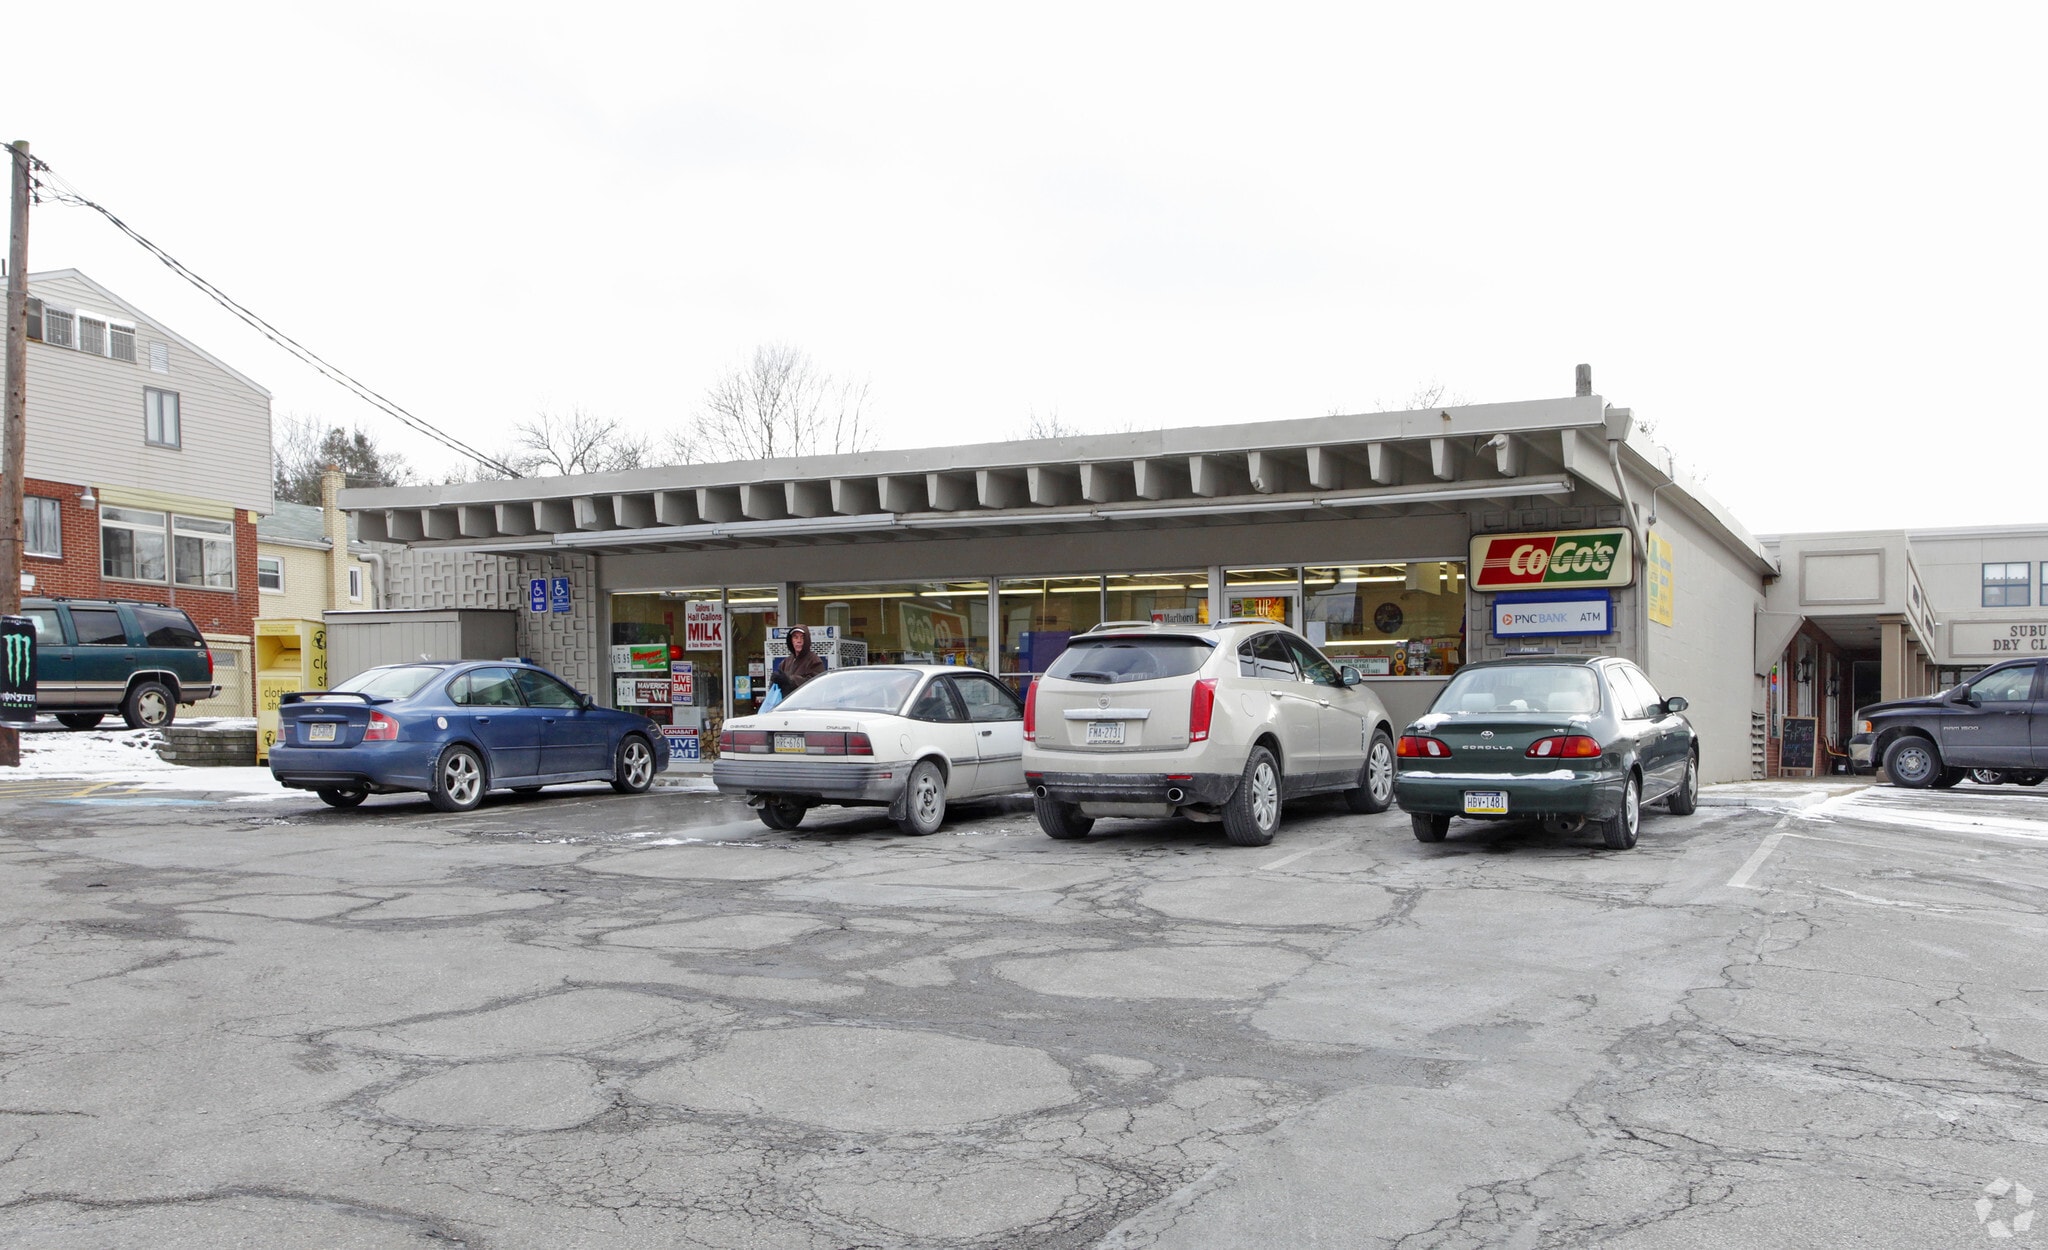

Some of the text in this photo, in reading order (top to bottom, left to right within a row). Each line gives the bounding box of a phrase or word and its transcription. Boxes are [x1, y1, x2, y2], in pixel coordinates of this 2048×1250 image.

[688, 612, 723, 621] Half Gallons
[1164, 613, 1194, 624] Marlboro
[1514, 612, 1601, 624] PNC BANK ATM
[688, 622, 722, 641] MILK
[2010, 625, 2047, 637] SUBU
[1993, 638, 2047, 651] DRY CL
[673, 675, 691, 683] LIVE
[637, 682, 669, 690] MAVERICK
[673, 683, 691, 692] BAIT
[669, 739, 697, 748] LIVE
[669, 749, 697, 758] BAIT
